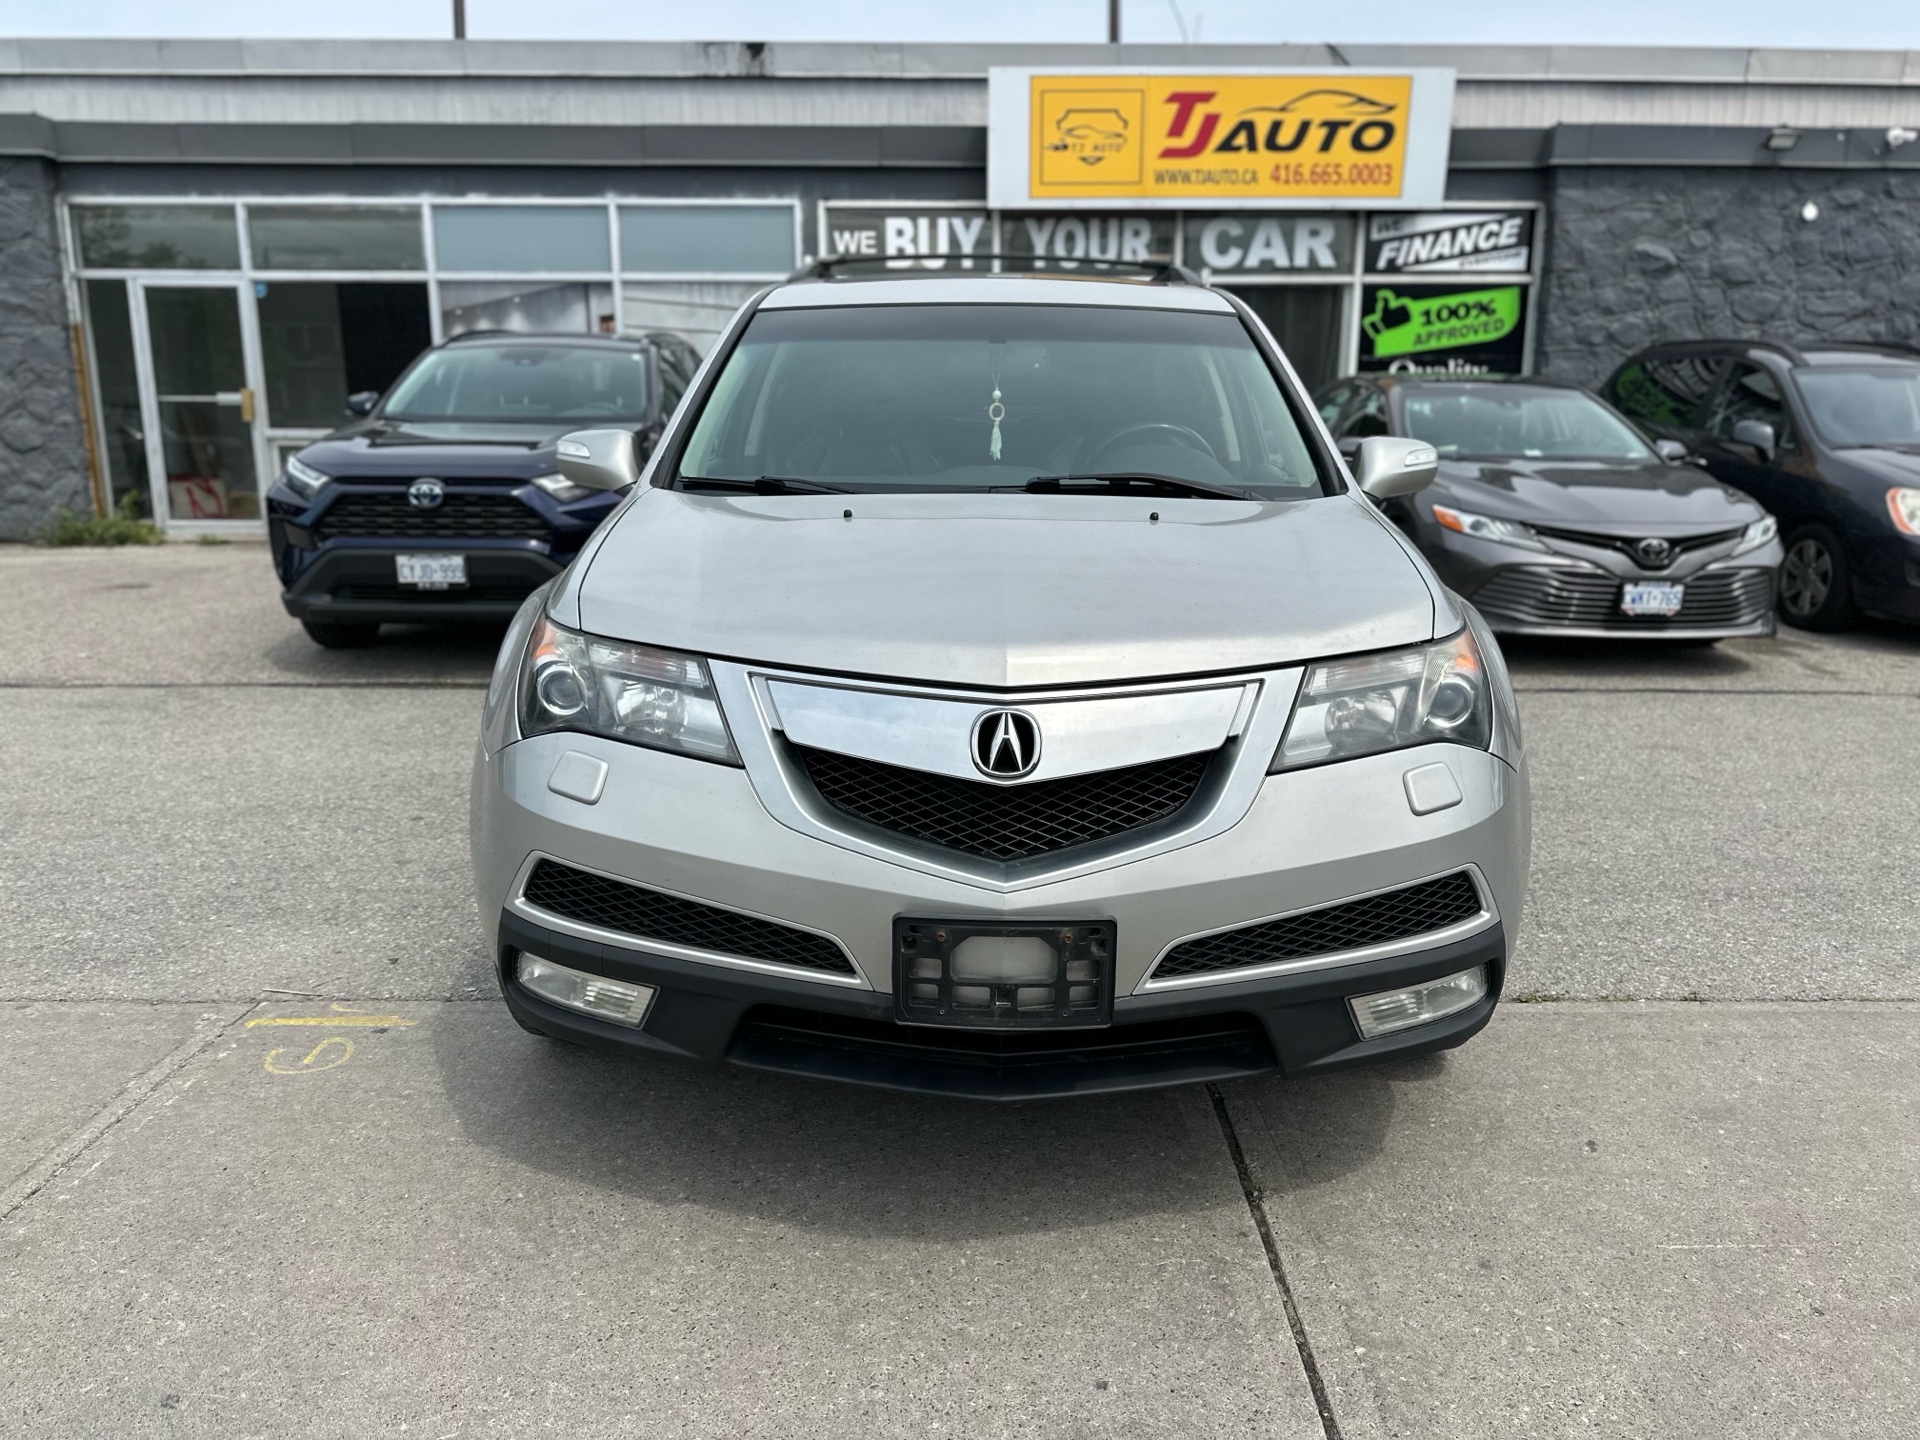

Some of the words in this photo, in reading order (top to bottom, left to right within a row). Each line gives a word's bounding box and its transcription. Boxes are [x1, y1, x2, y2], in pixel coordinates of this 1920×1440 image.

[1213, 119, 1397, 153] AUTO
[1270, 163, 1393, 186] 416.665.0003
[833, 230, 877, 254] WE
[884, 216, 985, 270] BUY
[1025, 216, 1151, 270] YOUR
[1200, 219, 1338, 269] CAR
[1375, 216, 1523, 271] FINANCE
[1419, 298, 1497, 327] 100%
[1413, 318, 1505, 347] APPROVED
